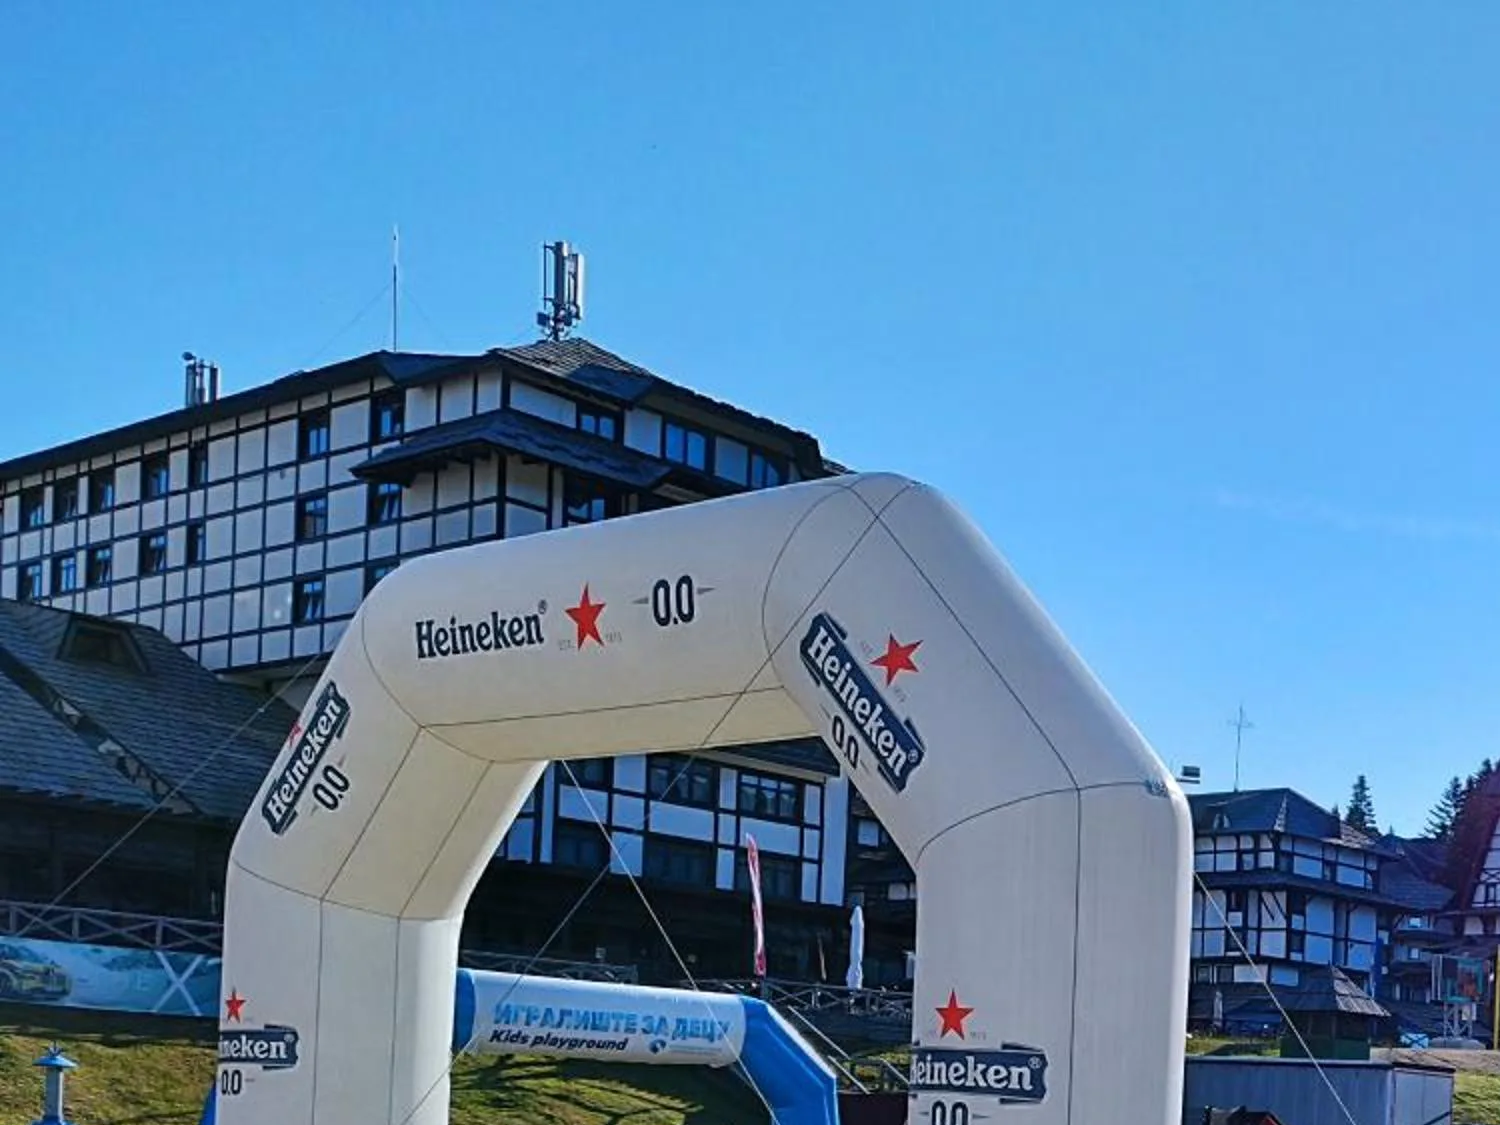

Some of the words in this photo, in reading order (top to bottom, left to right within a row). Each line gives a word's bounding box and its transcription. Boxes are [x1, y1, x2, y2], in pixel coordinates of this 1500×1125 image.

[416, 610, 545, 659] Heineken
[652, 575, 695, 627] 0.0
[807, 627, 907, 777] Heineken
[266, 698, 342, 823] Heineken
[832, 715, 859, 770] 0.0
[312, 765, 349, 811] 0.0
[489, 1029, 531, 1046] Kids
[530, 1031, 629, 1051] playground
[641, 1015, 669, 1036] ЗА
